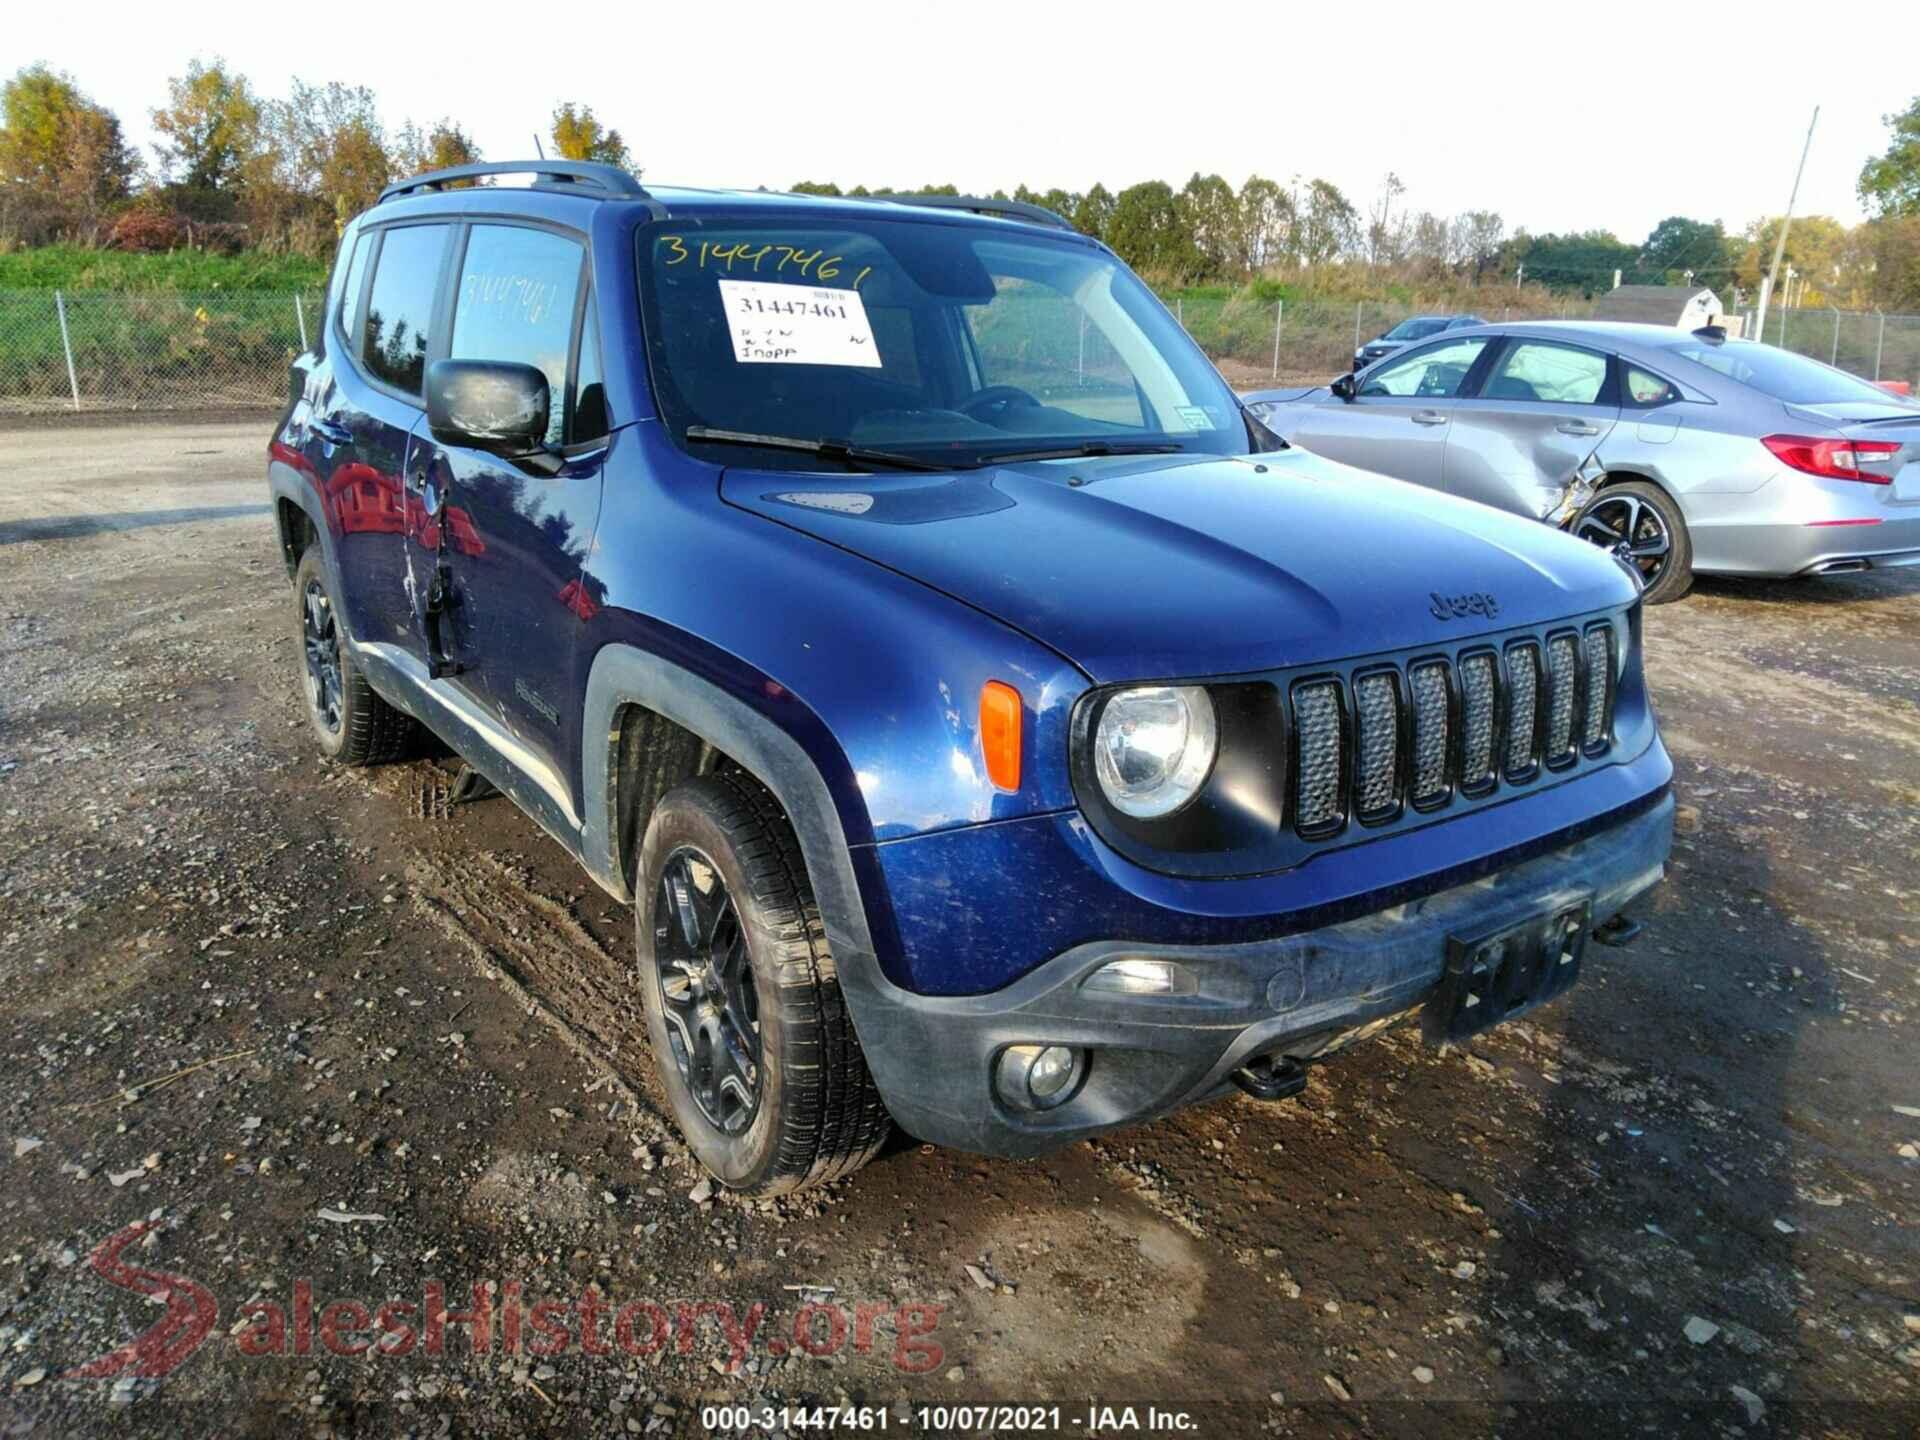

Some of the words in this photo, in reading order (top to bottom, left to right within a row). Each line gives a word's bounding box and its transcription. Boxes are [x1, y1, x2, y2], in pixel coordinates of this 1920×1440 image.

[660, 236, 872, 289] 31447461
[740, 298, 847, 319] 31447461
[1429, 592, 1500, 620] Jeep
